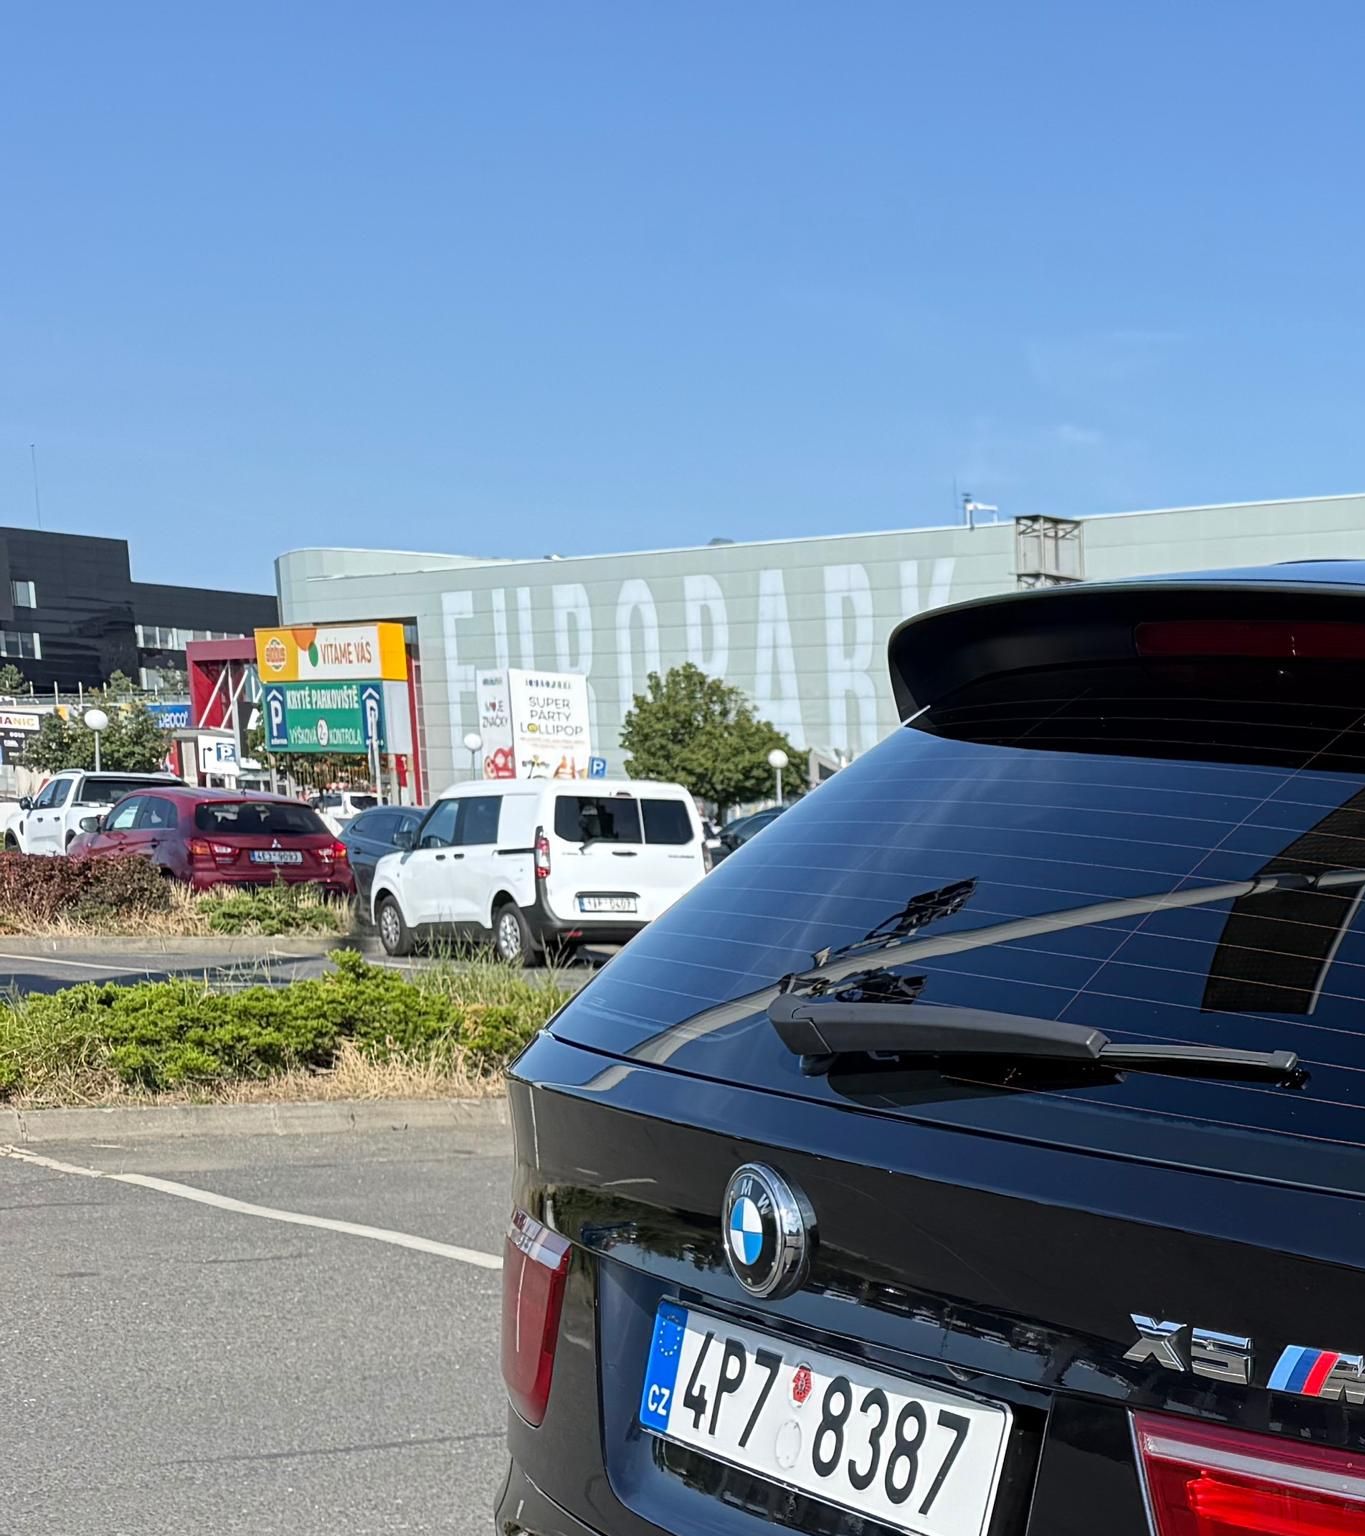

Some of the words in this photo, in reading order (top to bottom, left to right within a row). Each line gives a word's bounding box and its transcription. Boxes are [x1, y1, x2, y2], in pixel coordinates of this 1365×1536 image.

[356, 636, 372, 664] VÁS
[286, 685, 311, 709] KRYTÉ
[312, 684, 359, 709] PARKOVIŠTĚ
[529, 696, 571, 709] SUPER
[530, 709, 571, 722] PARTY
[329, 727, 362, 745] KONTROLA
[1122, 1313, 1254, 1386] X5
[648, 1383, 671, 1416] CZ
[683, 1330, 783, 1448] 4P7
[811, 1376, 971, 1516] 8387
